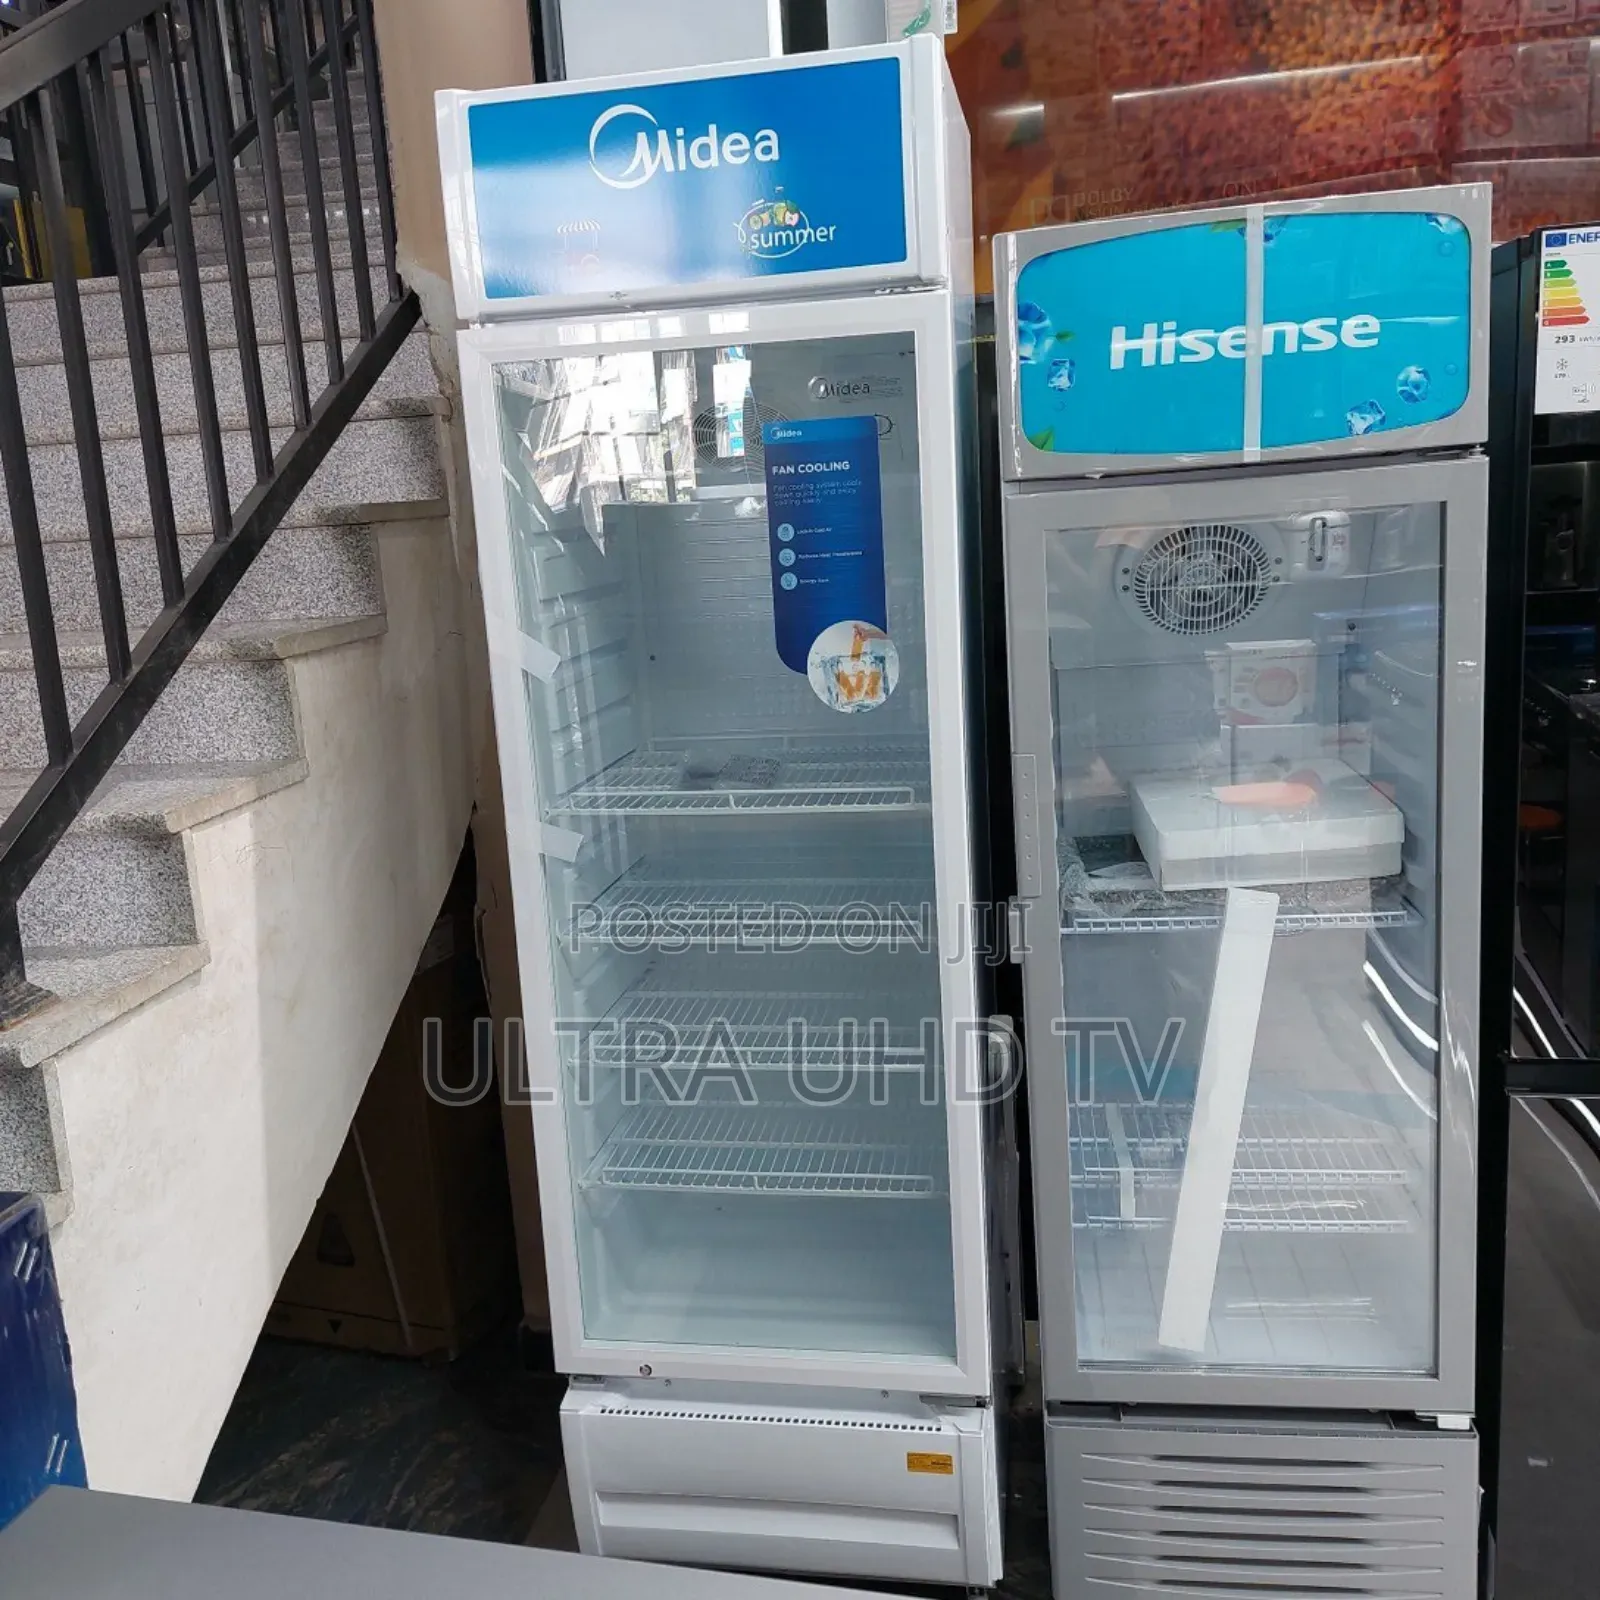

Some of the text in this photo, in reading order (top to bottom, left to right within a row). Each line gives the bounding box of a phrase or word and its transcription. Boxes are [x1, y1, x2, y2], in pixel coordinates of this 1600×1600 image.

[589, 103, 780, 189] Midea
[750, 224, 837, 250] summer
[1110, 314, 1381, 370] Hisense
[1554, 334, 1576, 344] 293
[807, 376, 871, 400] Midea
[770, 427, 803, 440] Midea
[772, 461, 851, 476] FAN COOLING
